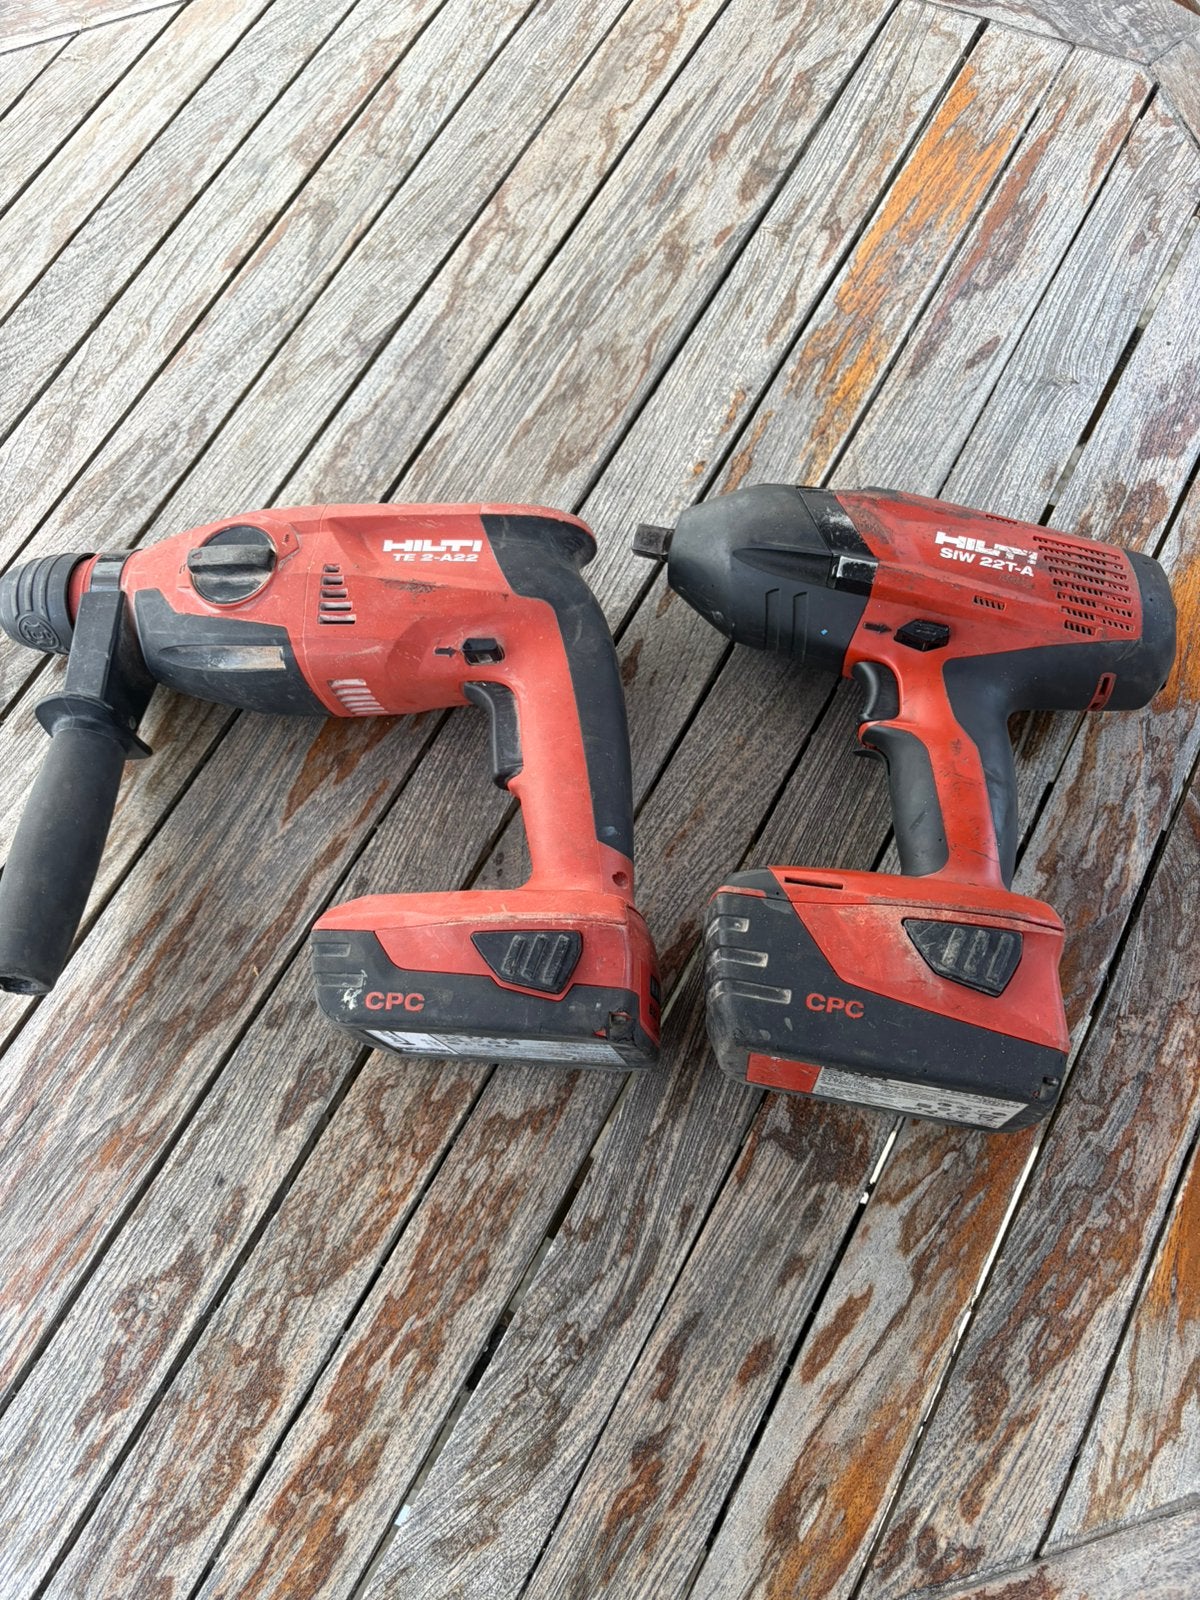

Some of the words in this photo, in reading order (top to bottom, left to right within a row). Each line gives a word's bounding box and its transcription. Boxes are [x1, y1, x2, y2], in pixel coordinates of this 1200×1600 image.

[383, 539, 482, 552] HILTI
[393, 553, 416, 562] TE
[421, 553, 478, 562] 2-A22
[935, 531, 1038, 565] HILTI
[940, 547, 976, 564] SIW
[979, 556, 1034, 577] 22T-A
[365, 991, 425, 1012] CPC
[805, 992, 865, 1019] CPC
